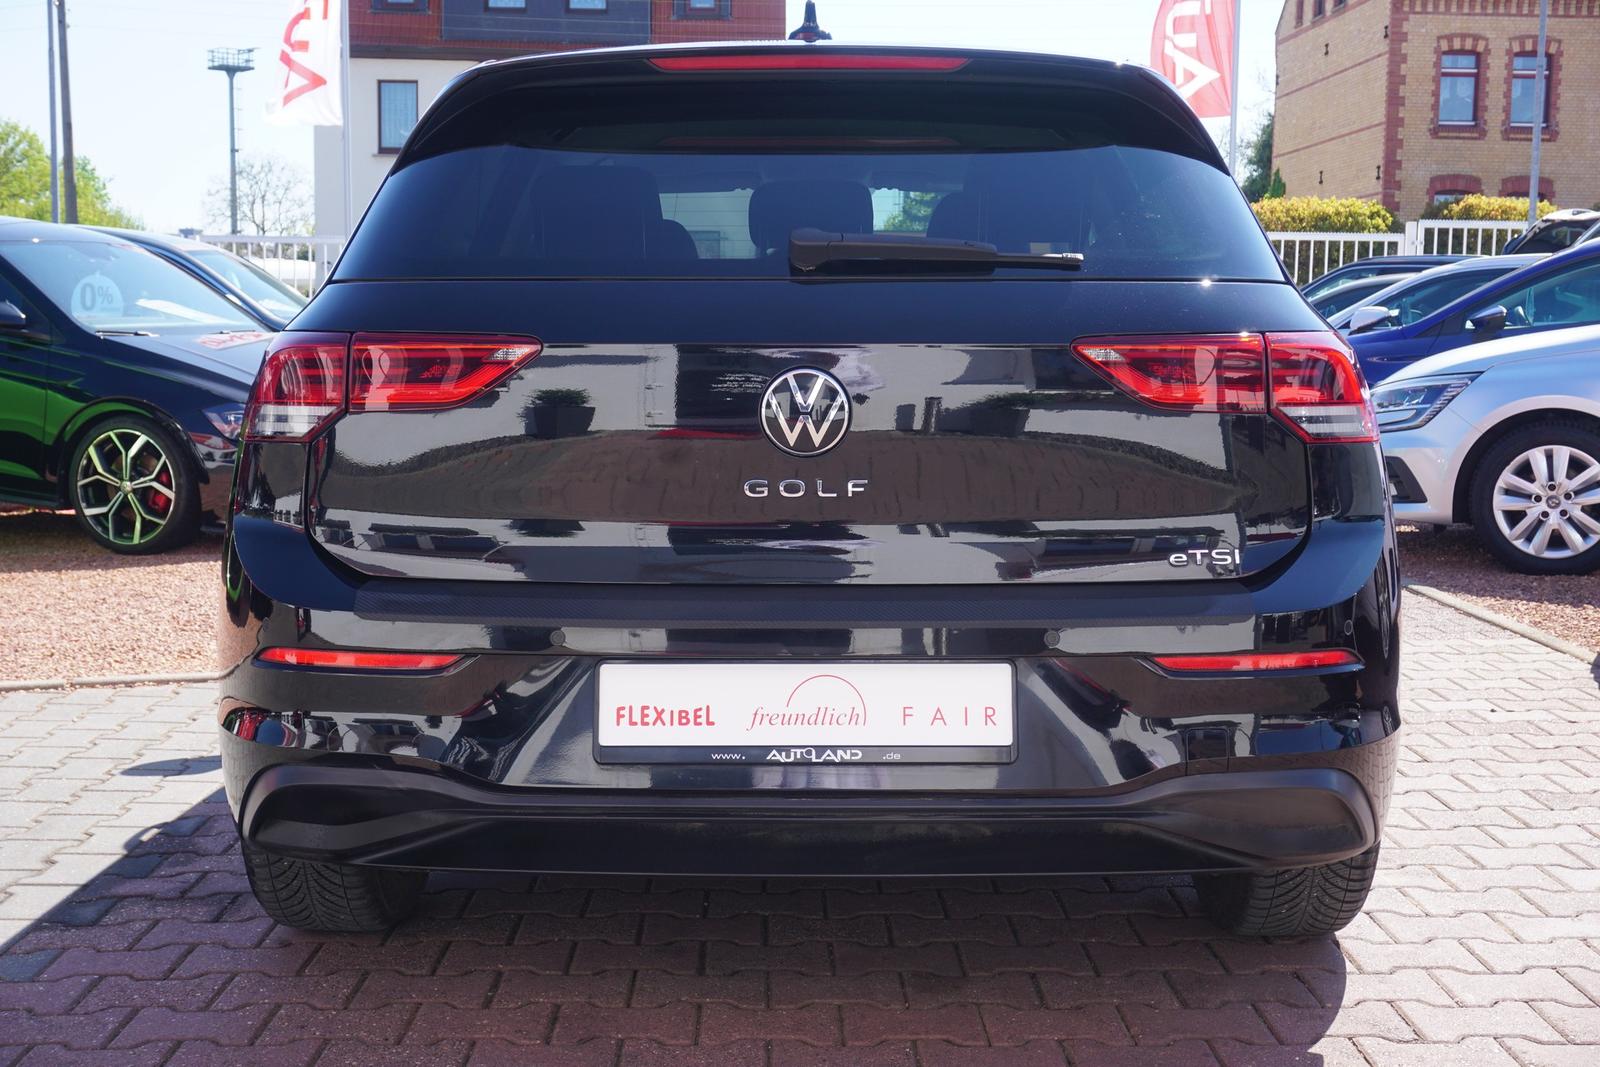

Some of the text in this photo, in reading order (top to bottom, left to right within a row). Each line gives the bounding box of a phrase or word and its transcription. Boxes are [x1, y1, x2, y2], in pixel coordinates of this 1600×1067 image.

[743, 479, 868, 498] GOLF
[1169, 549, 1240, 566] eTSI
[615, 705, 997, 731] FLEXIBEL freundlich FAIR
[766, 747, 863, 763] AUTOLAND
